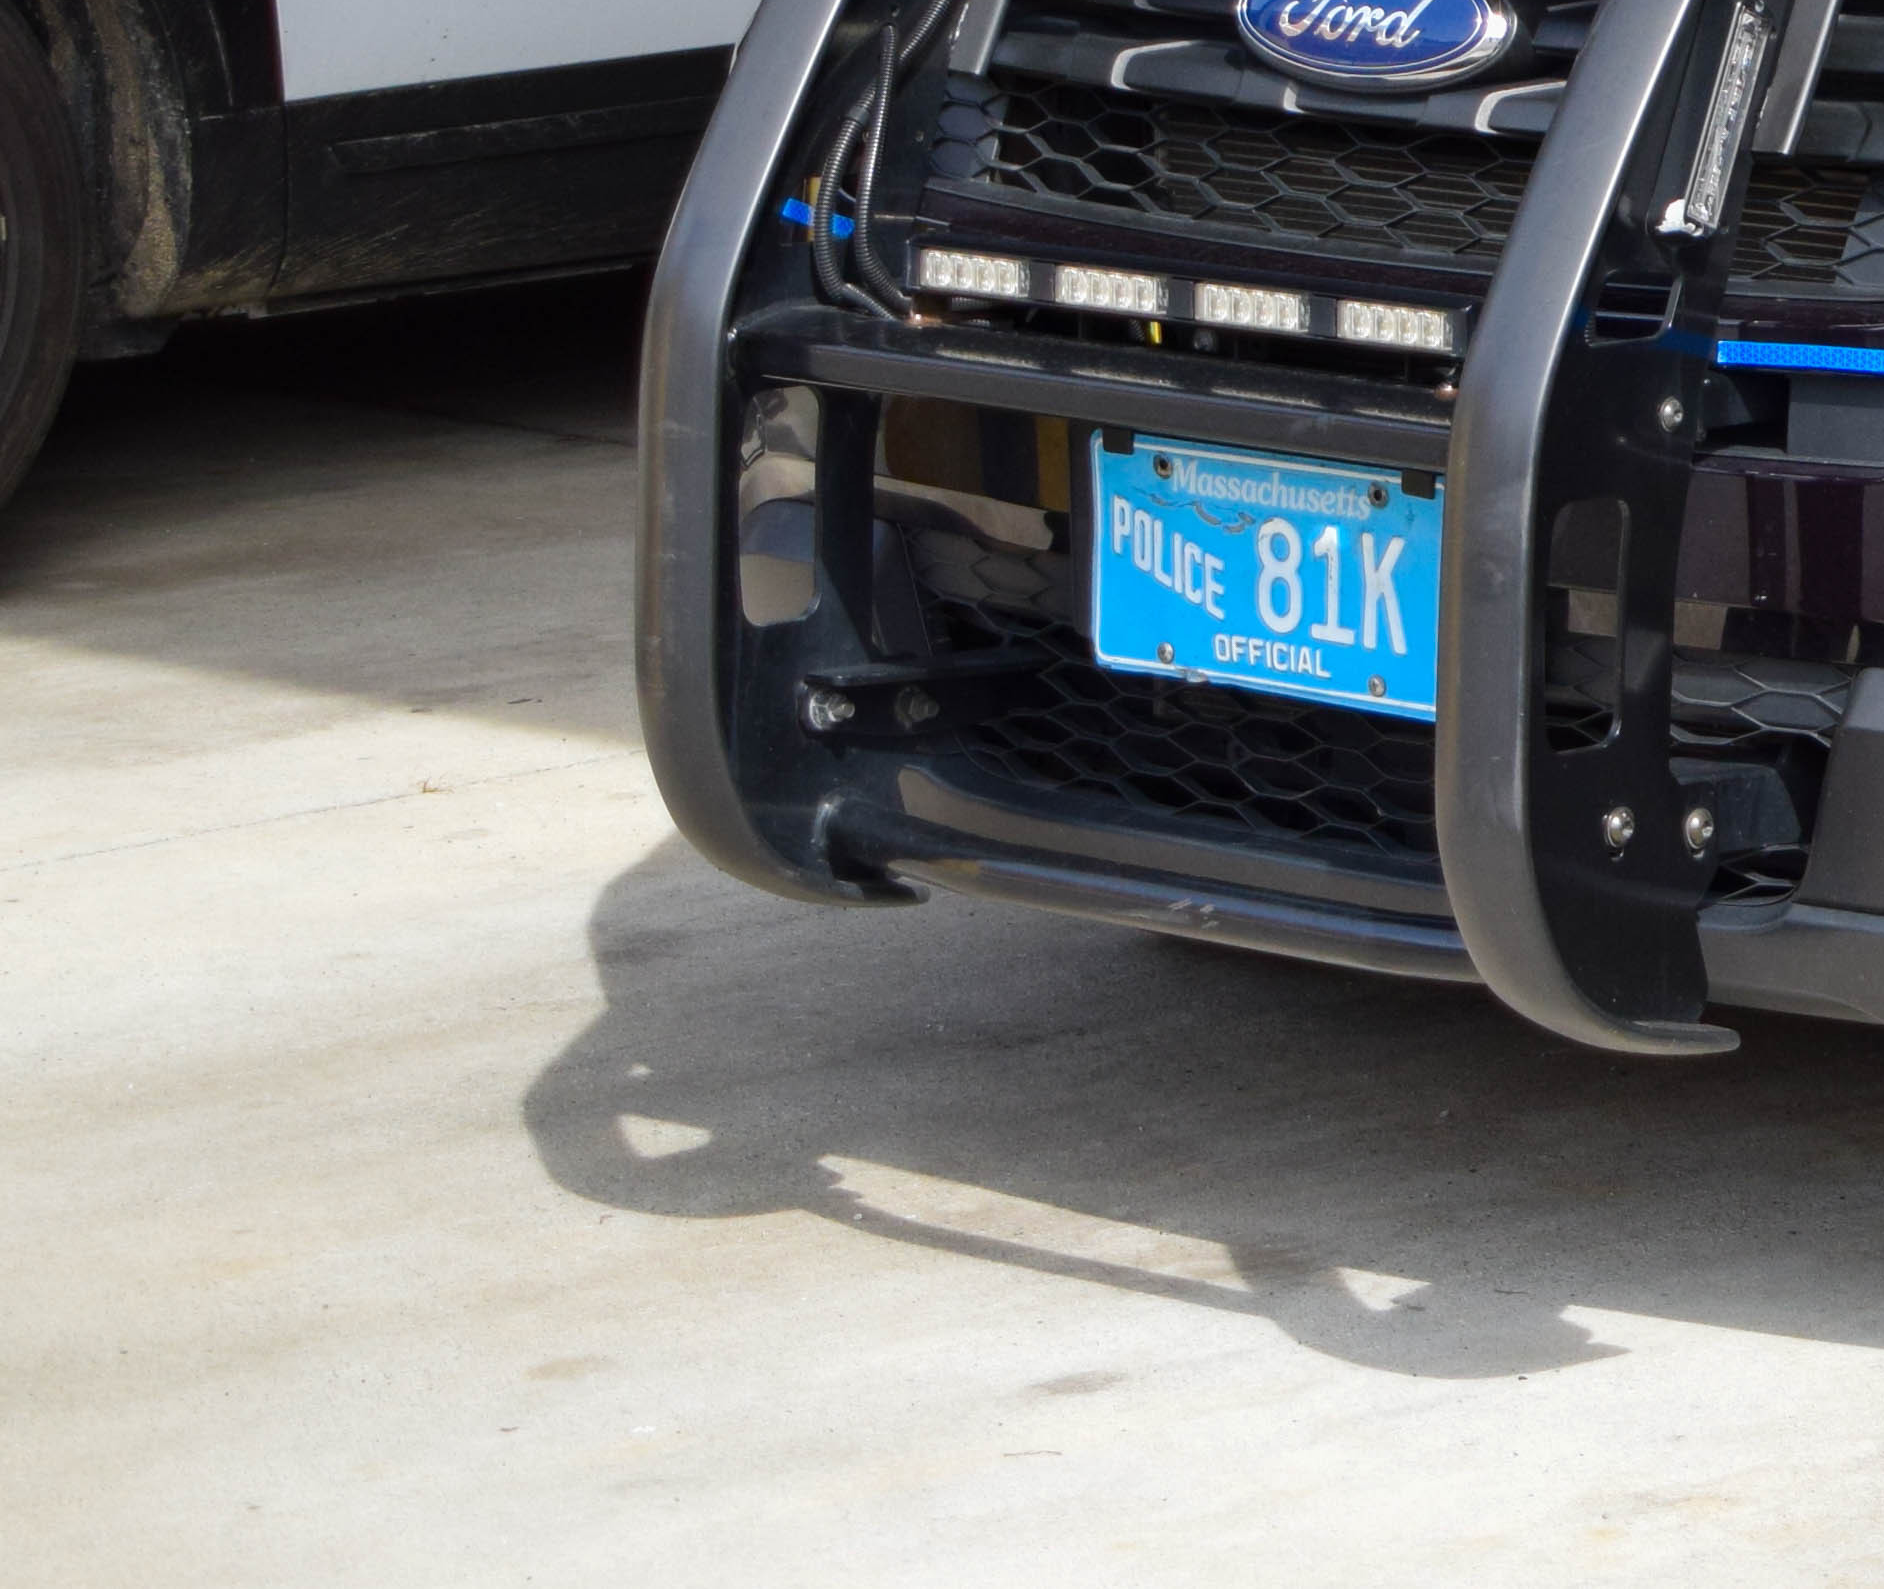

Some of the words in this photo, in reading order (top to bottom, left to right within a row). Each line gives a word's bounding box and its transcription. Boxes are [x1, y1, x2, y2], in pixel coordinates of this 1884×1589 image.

[1171, 456, 1371, 521] Massachusetts
[1112, 495, 1226, 620] POLICE
[1256, 516, 1407, 656] 81K
[1213, 632, 1331, 679] OFFICIAL
